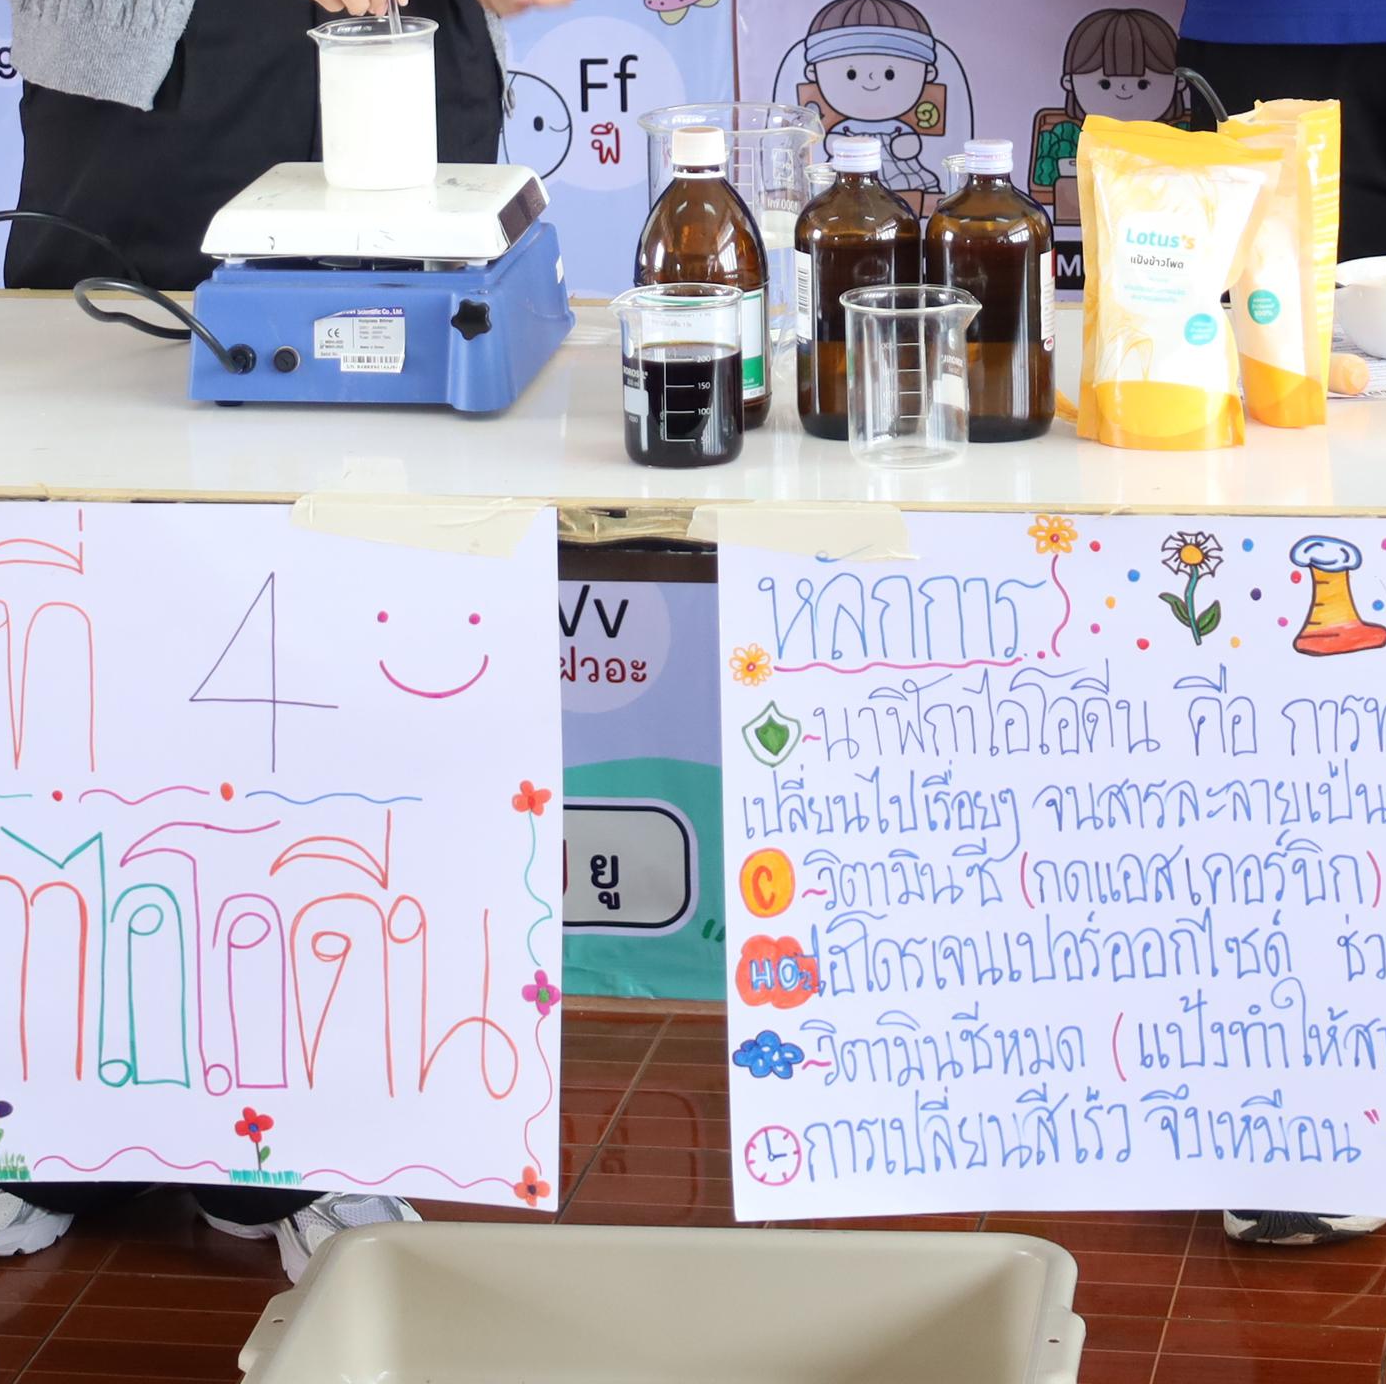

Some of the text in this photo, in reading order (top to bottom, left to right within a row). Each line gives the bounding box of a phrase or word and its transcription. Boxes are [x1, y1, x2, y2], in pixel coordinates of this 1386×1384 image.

[580, 54, 638, 112] Ff
[1126, 228, 1196, 250] Lotus's
[1130, 254, 1185, 269] แป้งข้าวโพด
[697, 382, 711, 390] 150
[188, 570, 340, 773] 4
[1173, 664, 1258, 757] คือ
